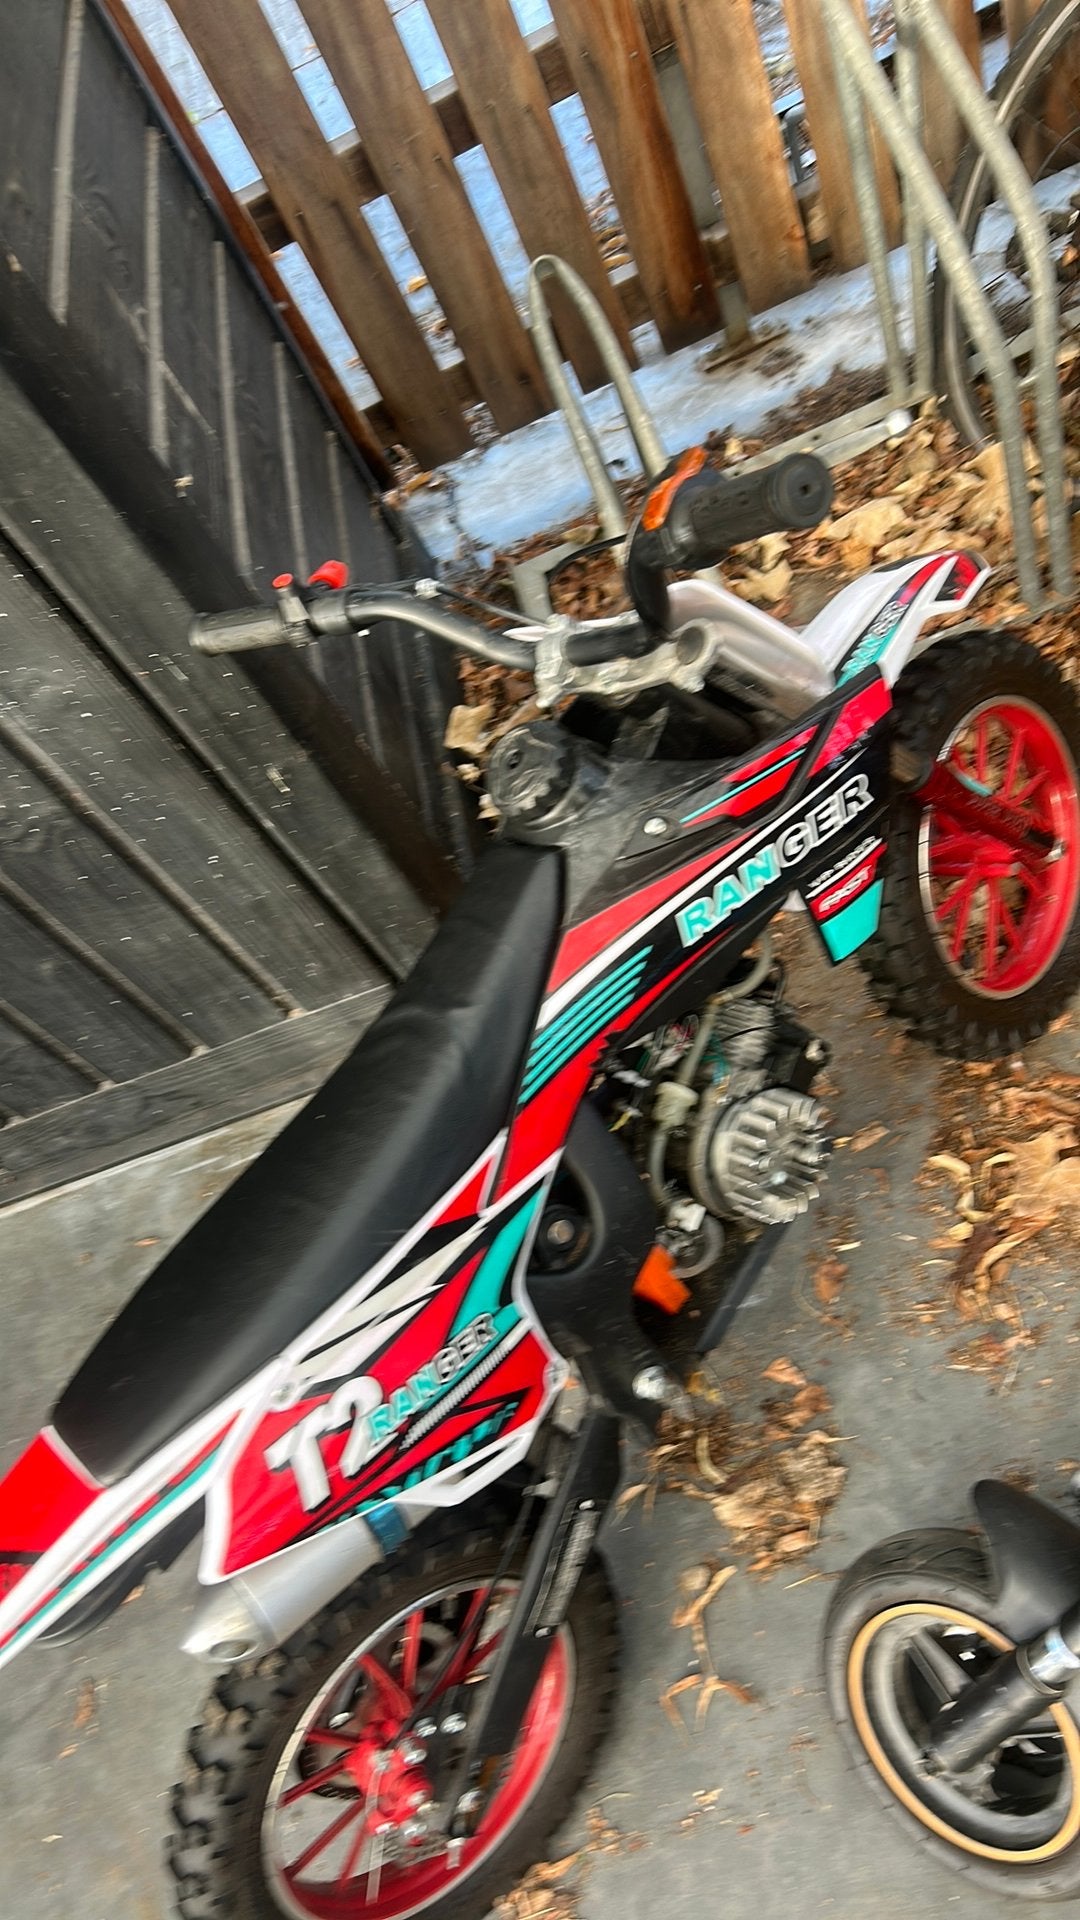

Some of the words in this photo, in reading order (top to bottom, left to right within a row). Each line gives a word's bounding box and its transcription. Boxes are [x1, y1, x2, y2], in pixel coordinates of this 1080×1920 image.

[674, 774, 875, 948] RANGER
[263, 1375, 398, 1512] T2
[366, 1312, 500, 1443] RANGER
